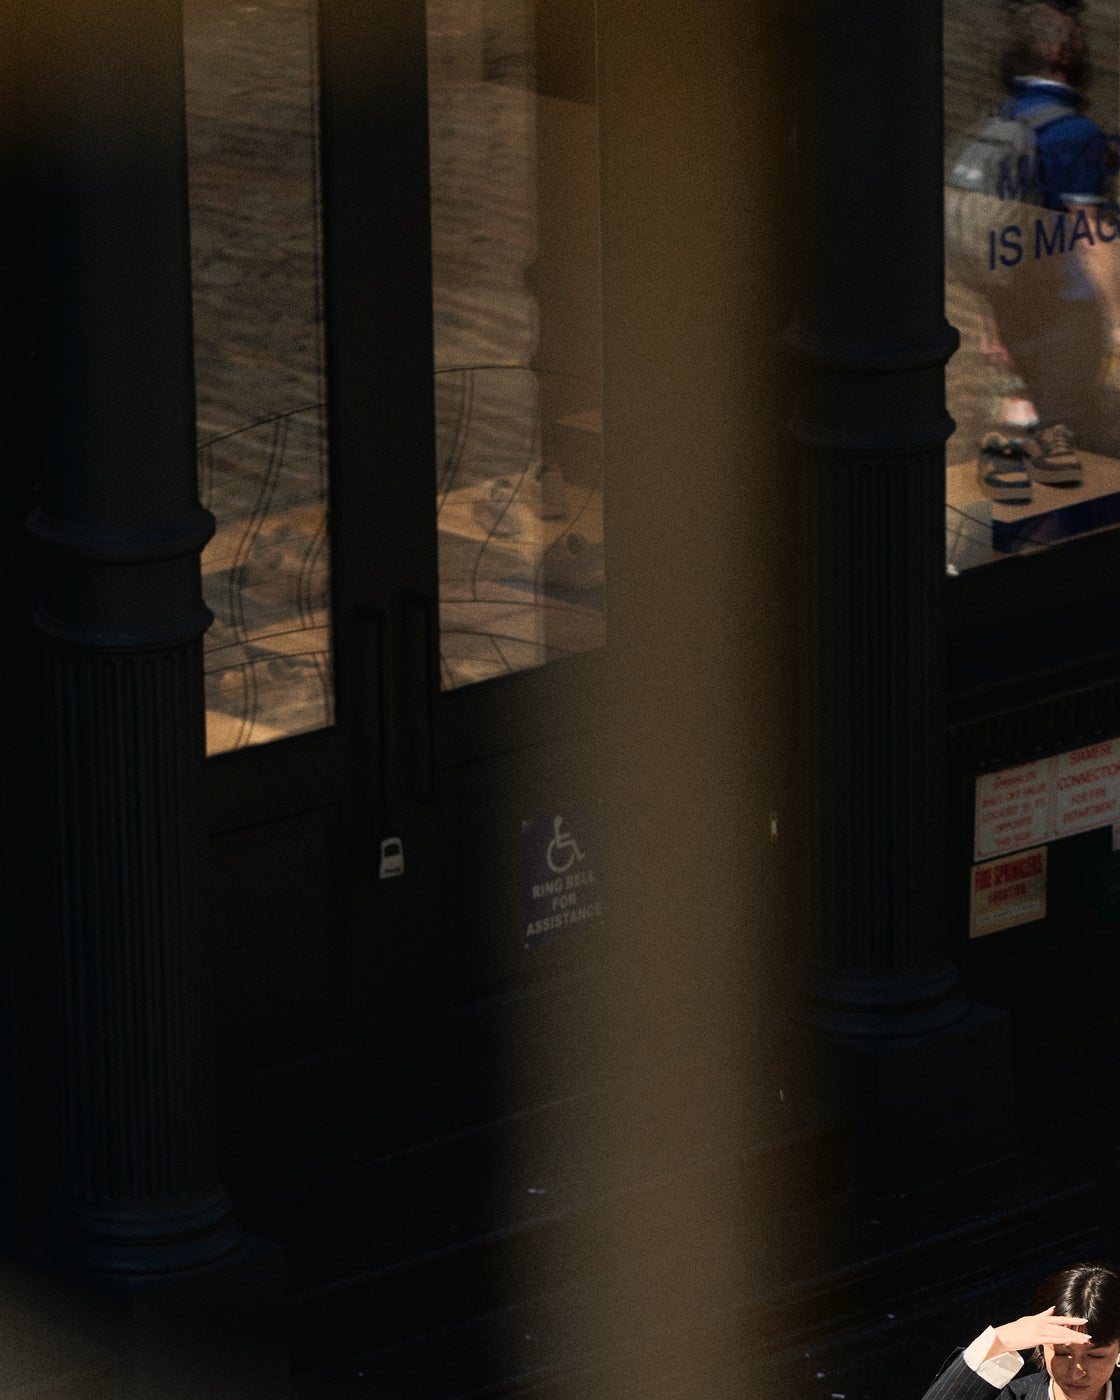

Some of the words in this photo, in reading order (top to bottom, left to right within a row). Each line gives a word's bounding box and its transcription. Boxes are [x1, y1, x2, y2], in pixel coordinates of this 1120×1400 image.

[989, 226, 1024, 270] IS
[532, 877, 563, 899] RING
[553, 892, 576, 911] FOR
[526, 903, 602, 937] ASSISTANCE
